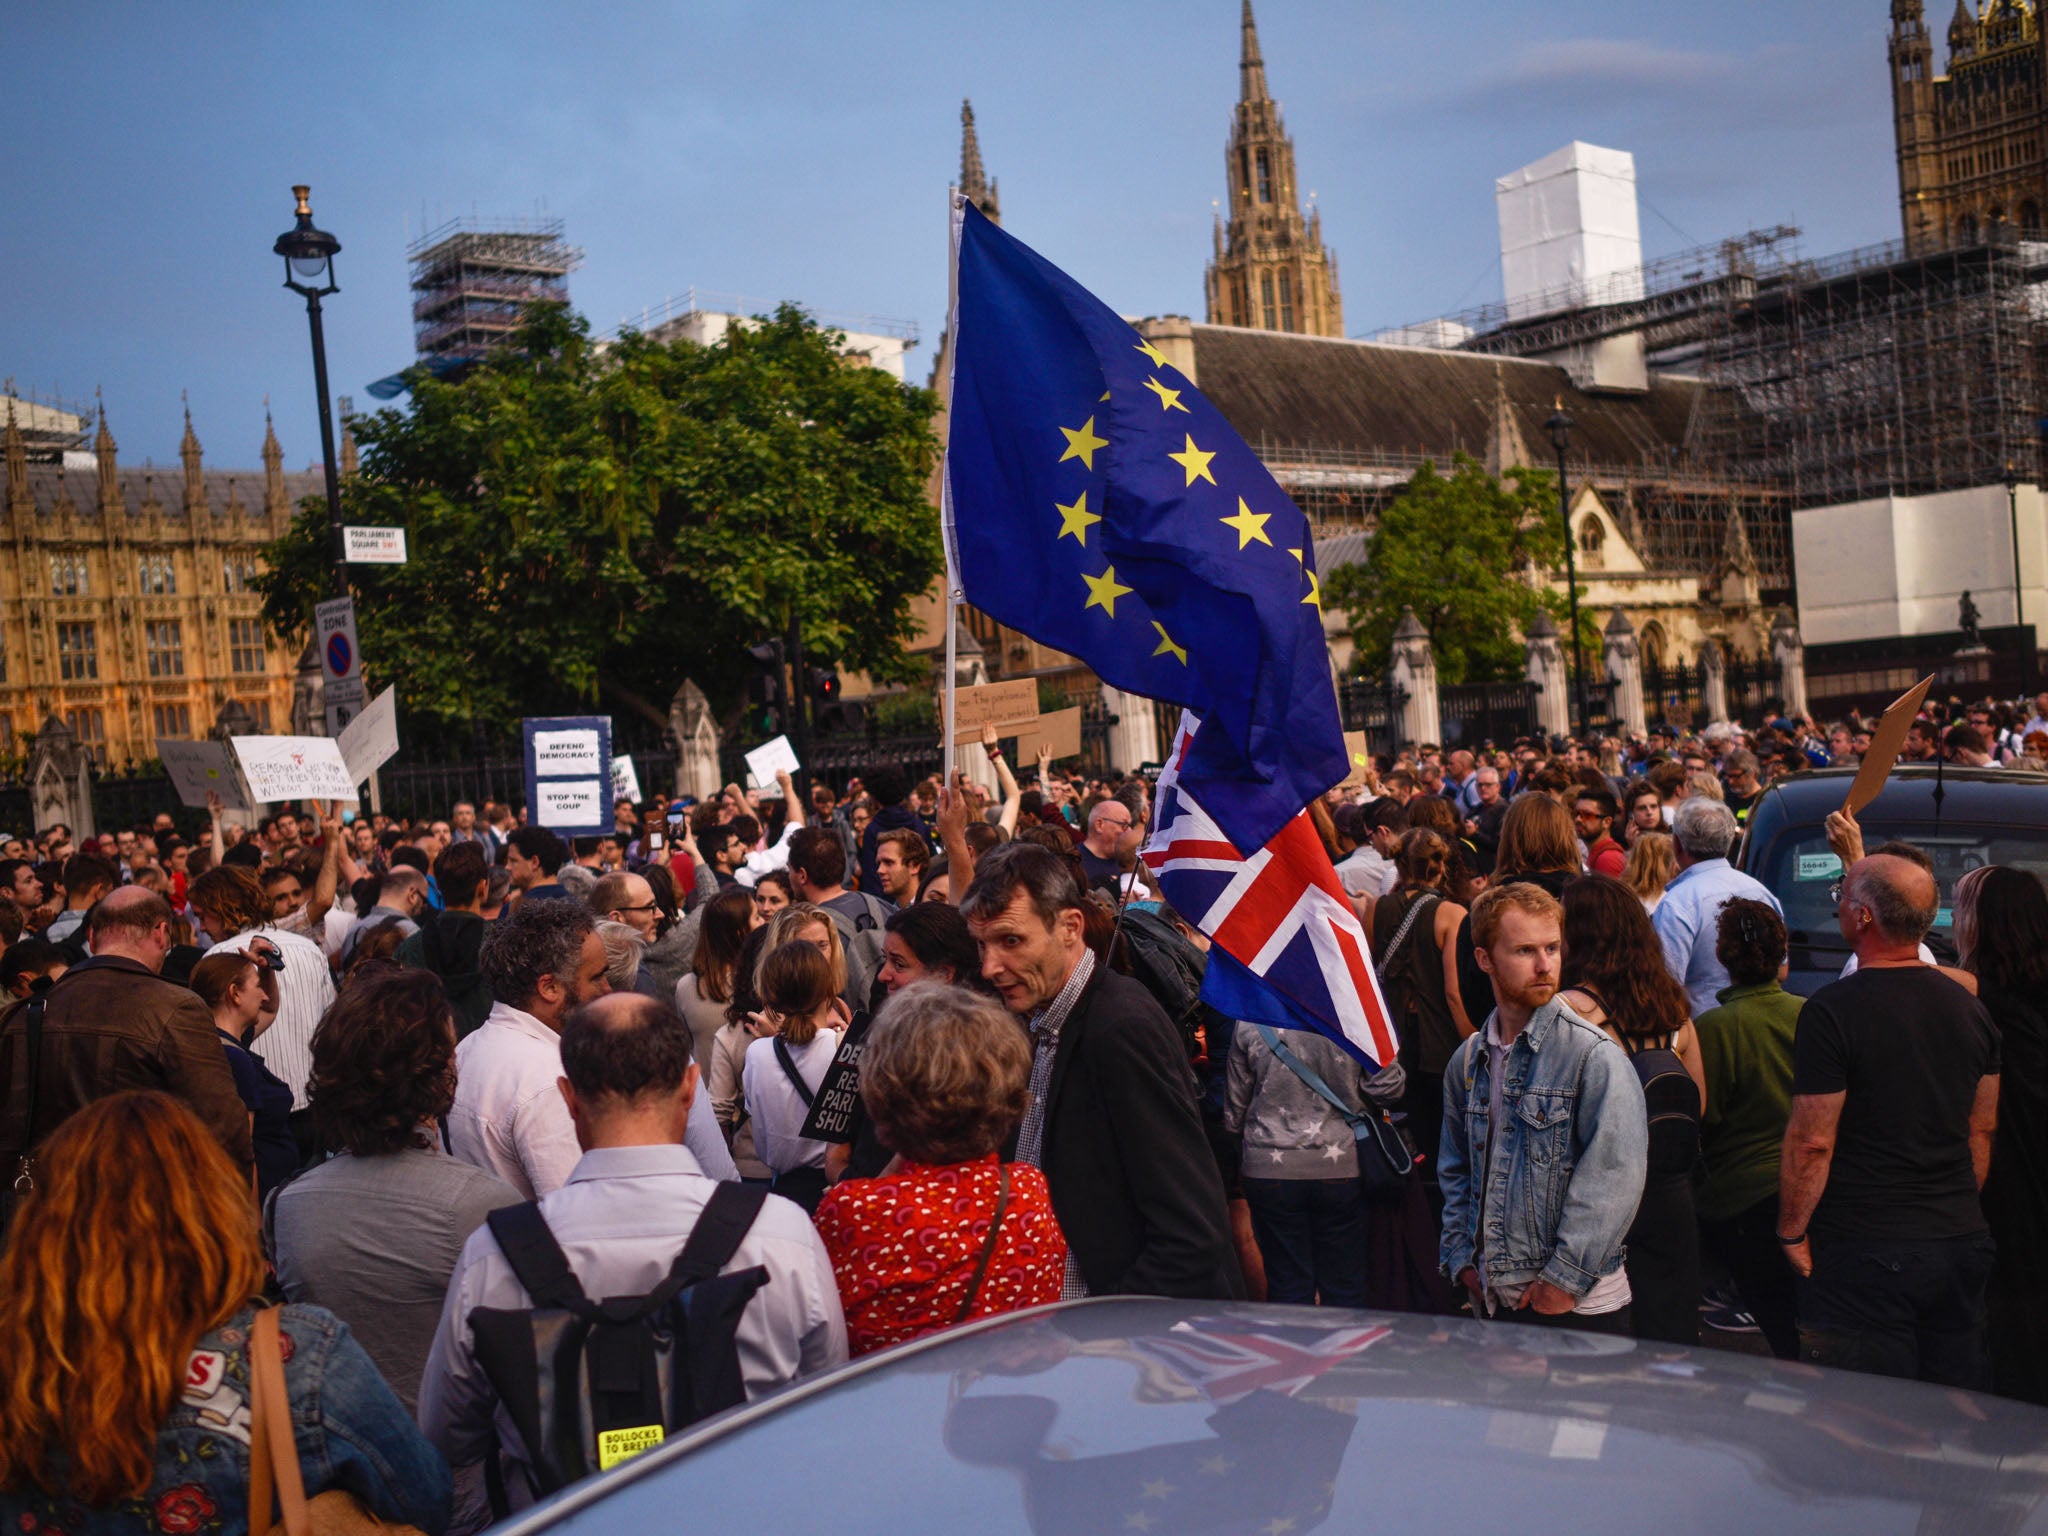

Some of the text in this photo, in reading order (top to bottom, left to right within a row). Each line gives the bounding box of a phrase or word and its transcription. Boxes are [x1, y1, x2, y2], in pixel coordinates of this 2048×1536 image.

[351, 530, 395, 538] PARLIAMENT
[351, 540, 379, 548] SQUARE
[323, 614, 348, 631] ZONE
[540, 752, 595, 760] DEMOCRACY
[815, 1110, 850, 1133] SHU
[187, 1354, 215, 1386] S
[606, 1429, 657, 1443] BOLLOCKS
[605, 1444, 619, 1454] TO
